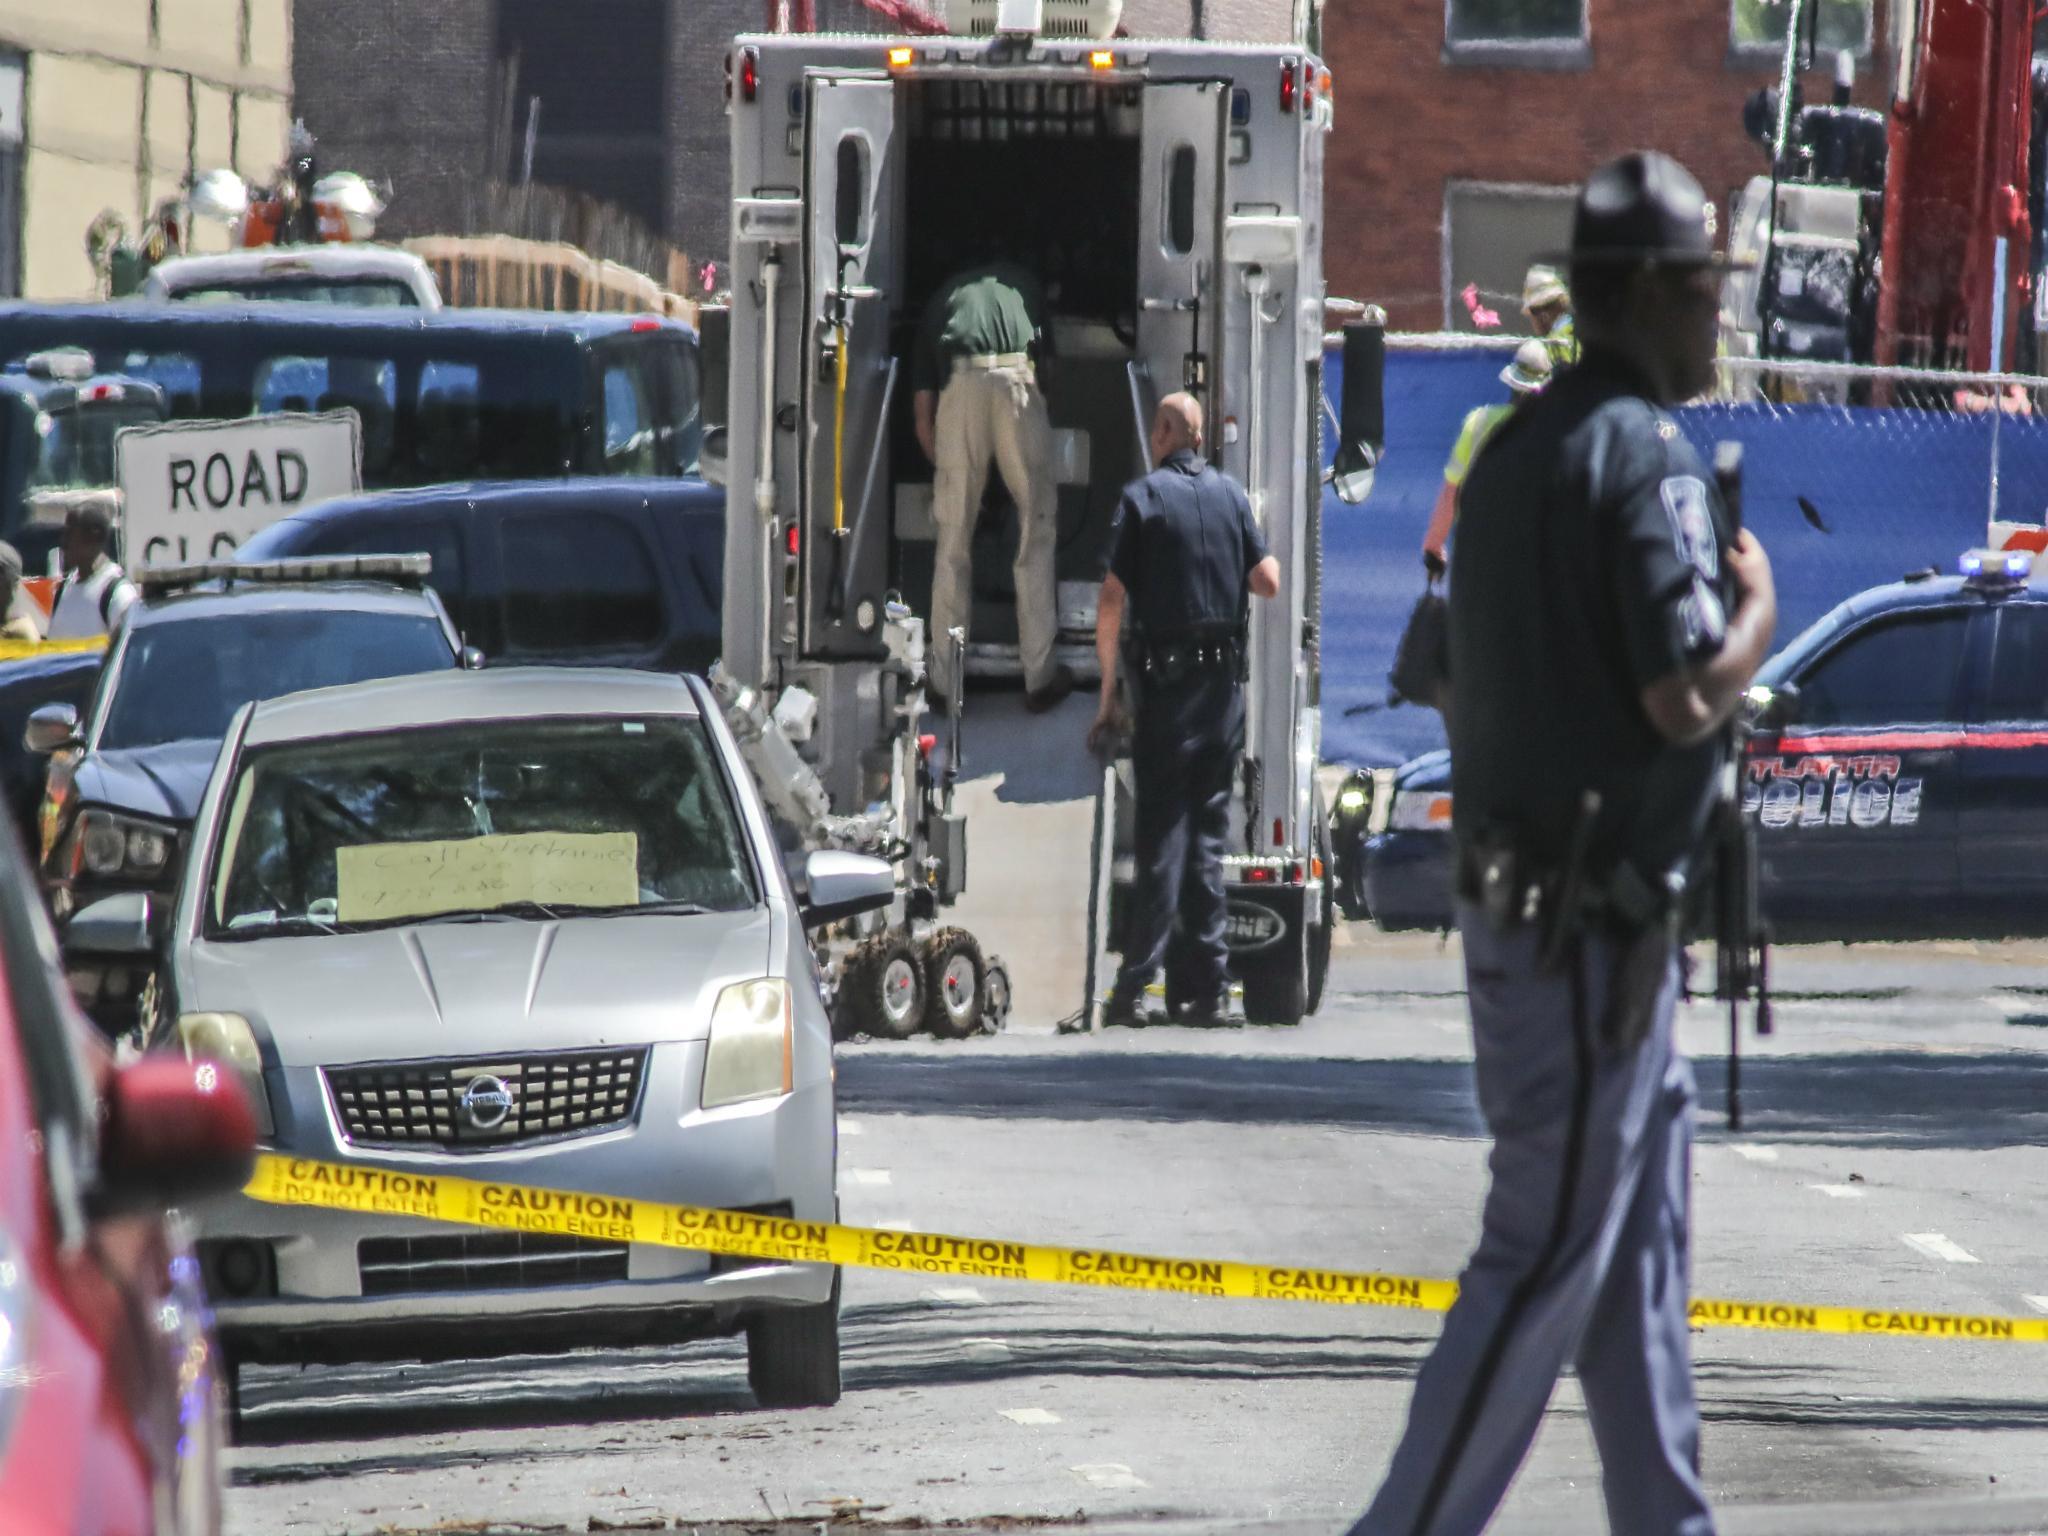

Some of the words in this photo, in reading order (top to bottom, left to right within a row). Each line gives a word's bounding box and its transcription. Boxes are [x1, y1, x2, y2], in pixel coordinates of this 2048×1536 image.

[170, 450, 308, 510] ROAD
[289, 1159, 437, 1197] CAUTION
[286, 1183, 315, 1202] DO
[322, 1189, 361, 1208] NOT
[372, 1195, 439, 1218] ENTER
[481, 1186, 633, 1220] CAUTION
[480, 1207, 507, 1224] DO
[516, 1213, 557, 1230] NOT
[567, 1217, 635, 1239] ENTER
[677, 1207, 827, 1243] CAUTION
[675, 1230, 706, 1246] DO
[713, 1234, 753, 1252] NOT
[760, 1241, 831, 1261] ENTER
[873, 1232, 1026, 1265] CAUTION
[871, 1253, 900, 1268] DO
[910, 1257, 952, 1273] NOT
[959, 1262, 1028, 1280] ENTER
[1071, 1250, 1222, 1284] CAUTION
[1268, 1269, 1420, 1299] CAUTION
[1689, 1301, 1817, 1326] AUTION
[1863, 1312, 2014, 1336] CAUTION
